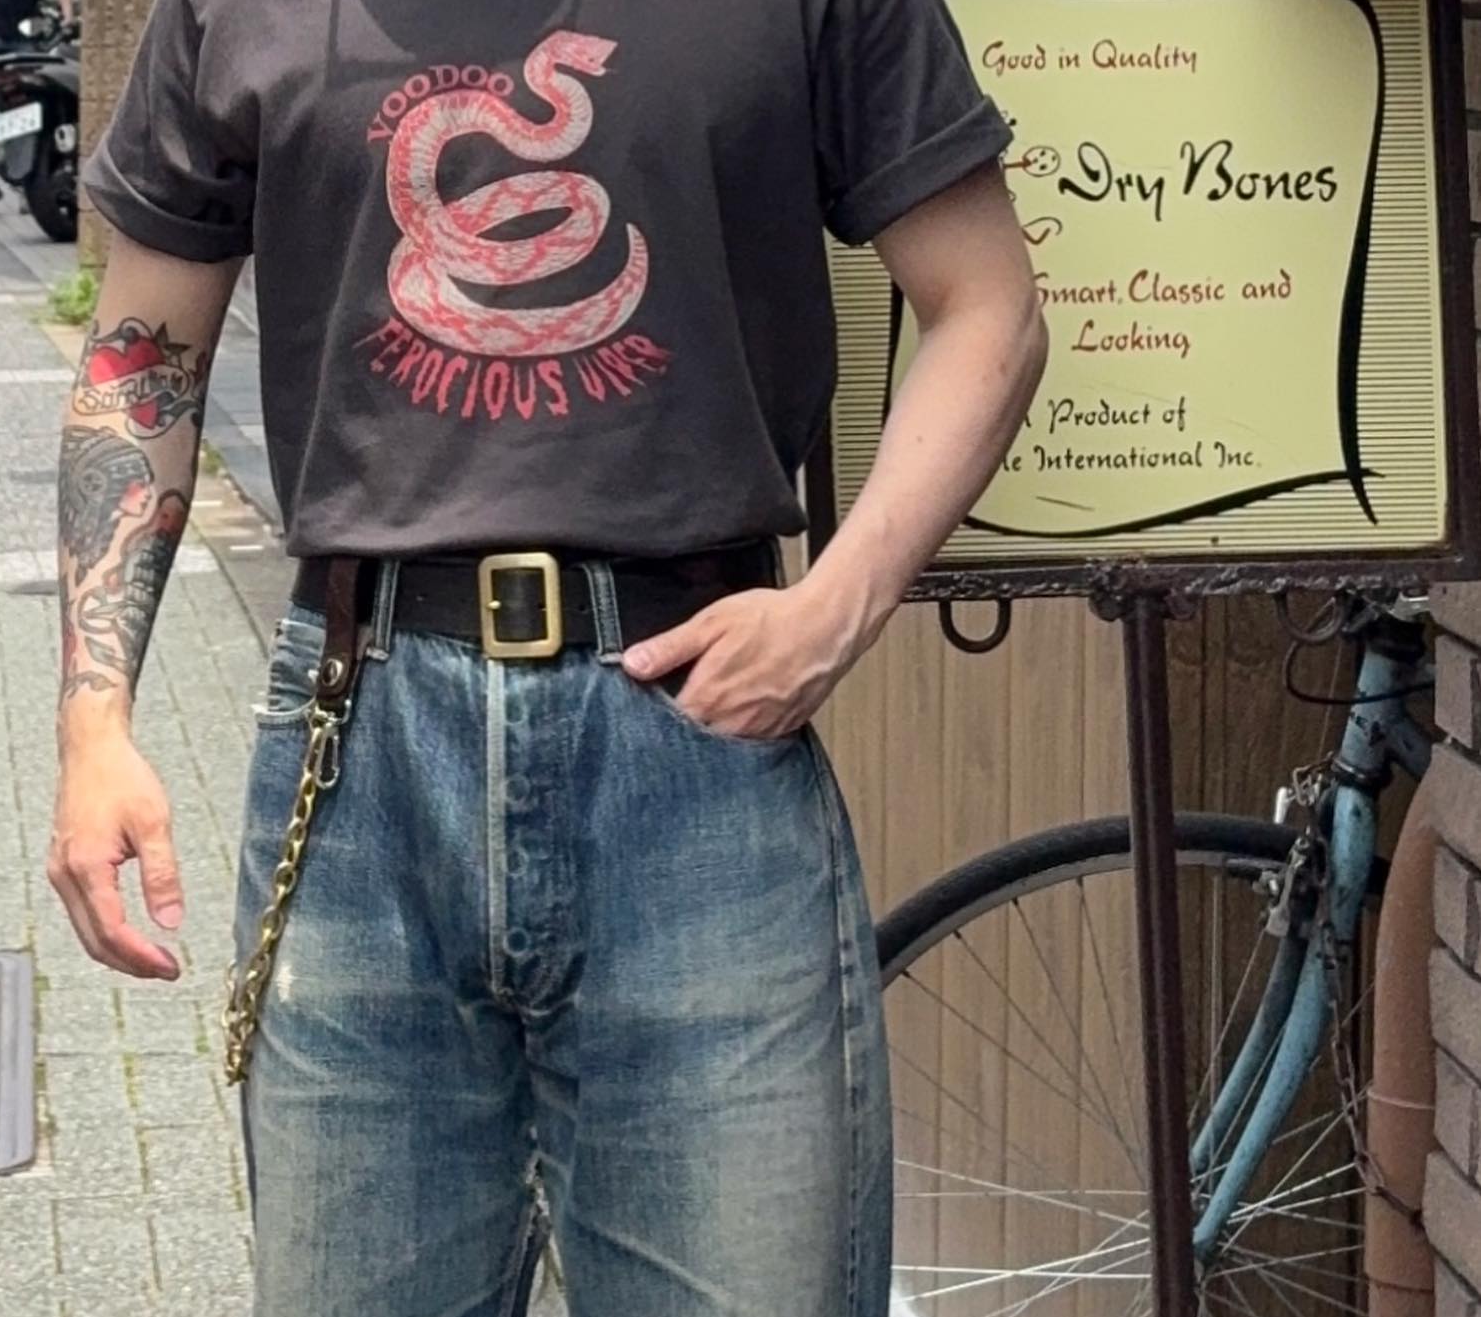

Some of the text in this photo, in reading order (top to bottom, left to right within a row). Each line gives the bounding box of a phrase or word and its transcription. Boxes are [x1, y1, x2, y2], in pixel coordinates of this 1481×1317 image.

[981, 38, 1198, 78] Good in Quality
[366, 63, 516, 144] VOODOO
[1057, 138, 1338, 222] Dry Bones
[1128, 268, 1226, 303] Classic
[1241, 267, 1293, 300] and
[1071, 319, 1191, 359] Looking
[351, 315, 569, 422] FEROCIOUS
[1047, 397, 1151, 435] Product
[1162, 395, 1187, 432] of
[1033, 441, 1204, 472] International
